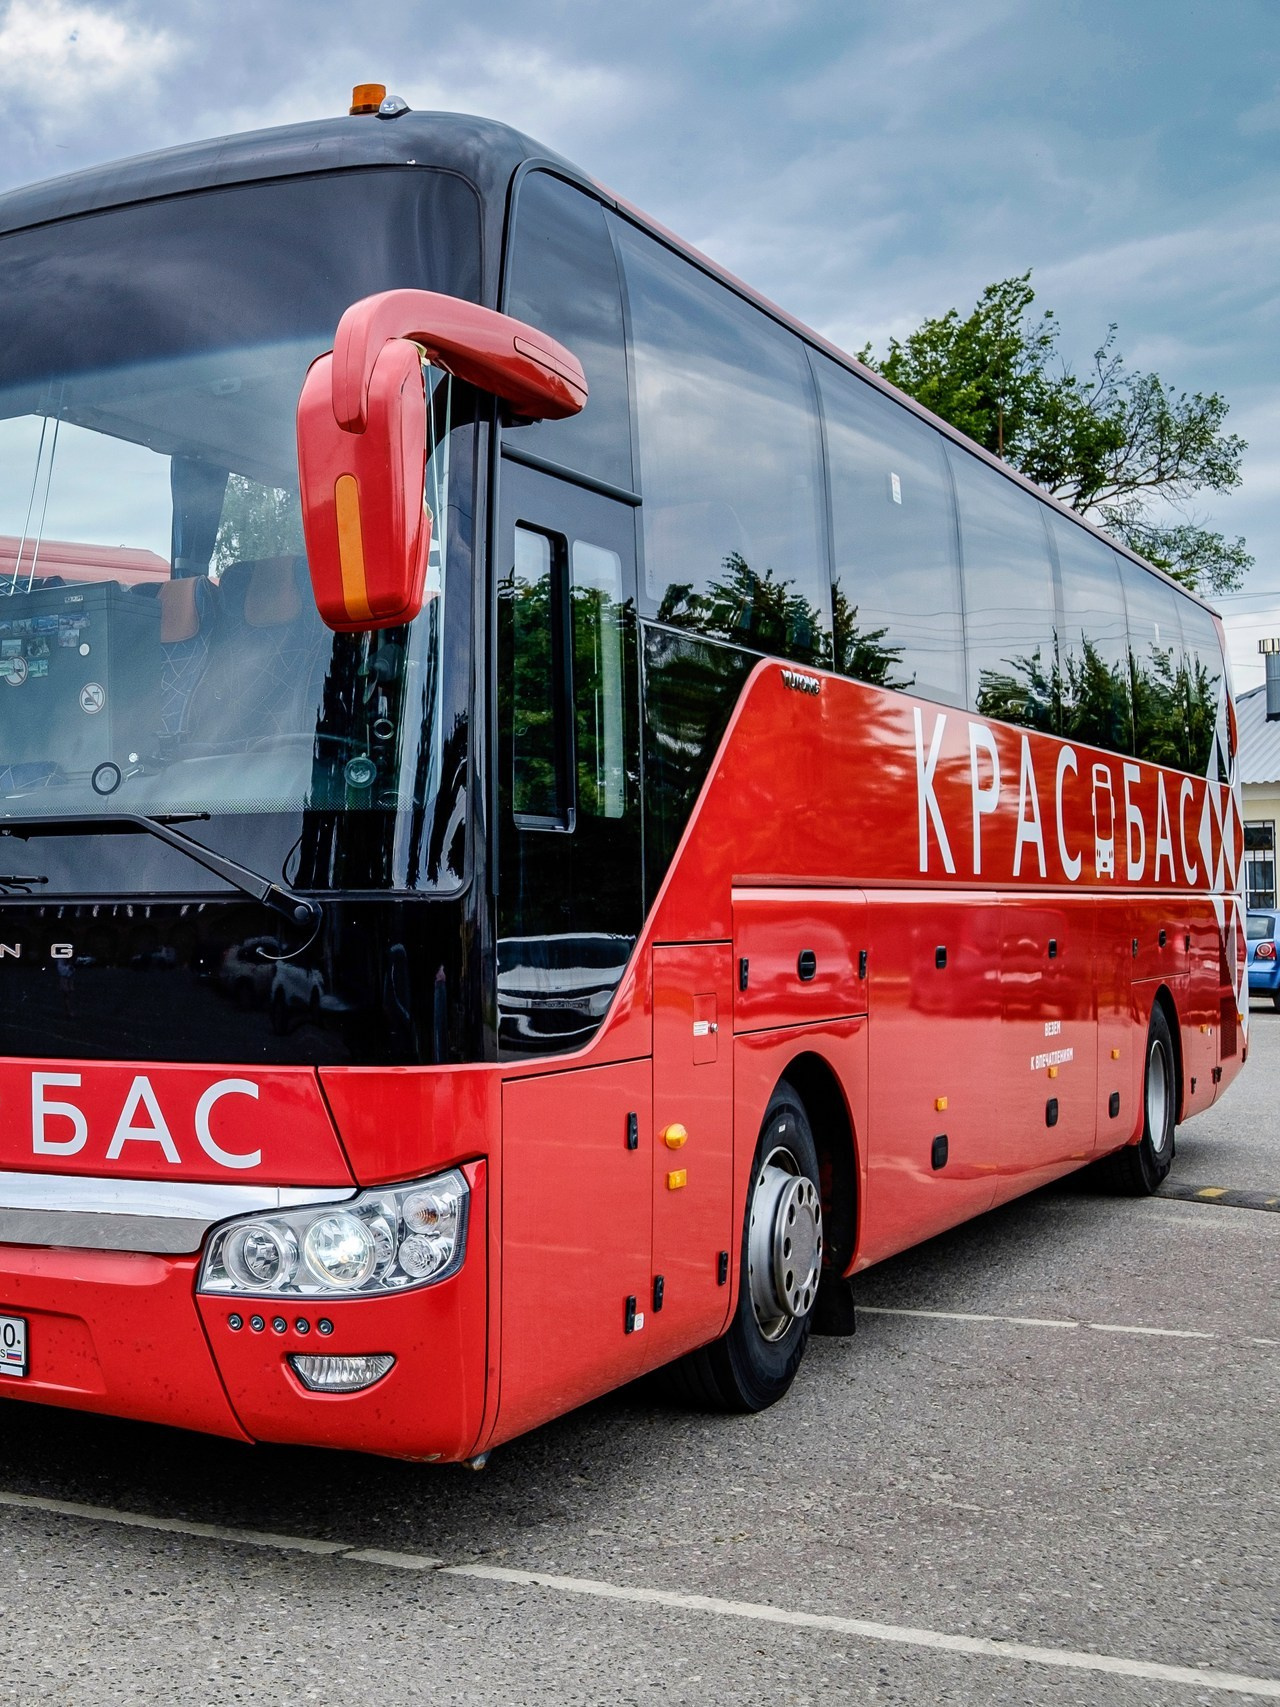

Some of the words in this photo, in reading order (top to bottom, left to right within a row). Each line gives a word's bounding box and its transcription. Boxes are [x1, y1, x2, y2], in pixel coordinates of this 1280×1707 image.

[781, 669, 821, 696] YUTONG
[913, 706, 1082, 882] КРАС
[1123, 761, 1198, 886] БАС
[32, 1071, 262, 1169] БАС
